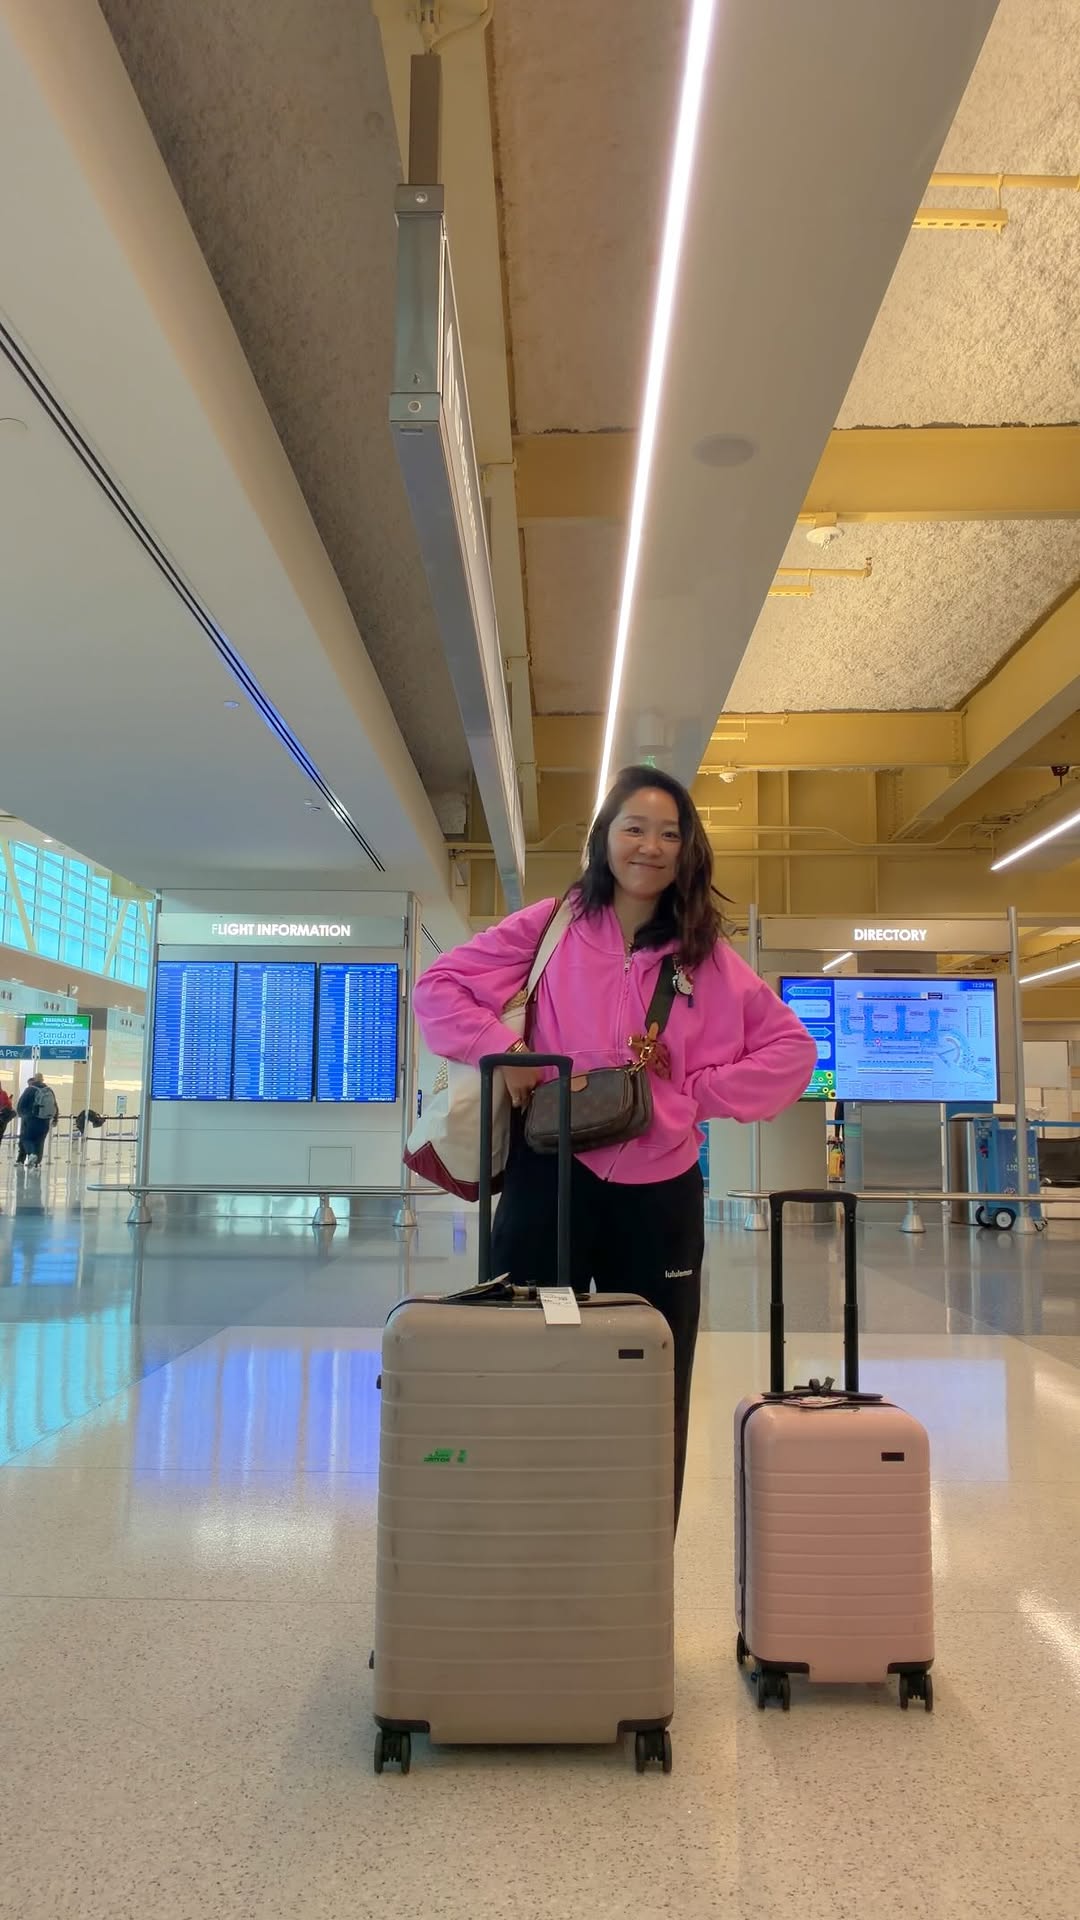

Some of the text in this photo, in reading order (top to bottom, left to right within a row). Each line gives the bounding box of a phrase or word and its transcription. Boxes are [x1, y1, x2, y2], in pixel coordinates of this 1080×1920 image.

[211, 923, 351, 937] FLIGHT INFORMATION
[853, 928, 928, 942] DIRECTORY
